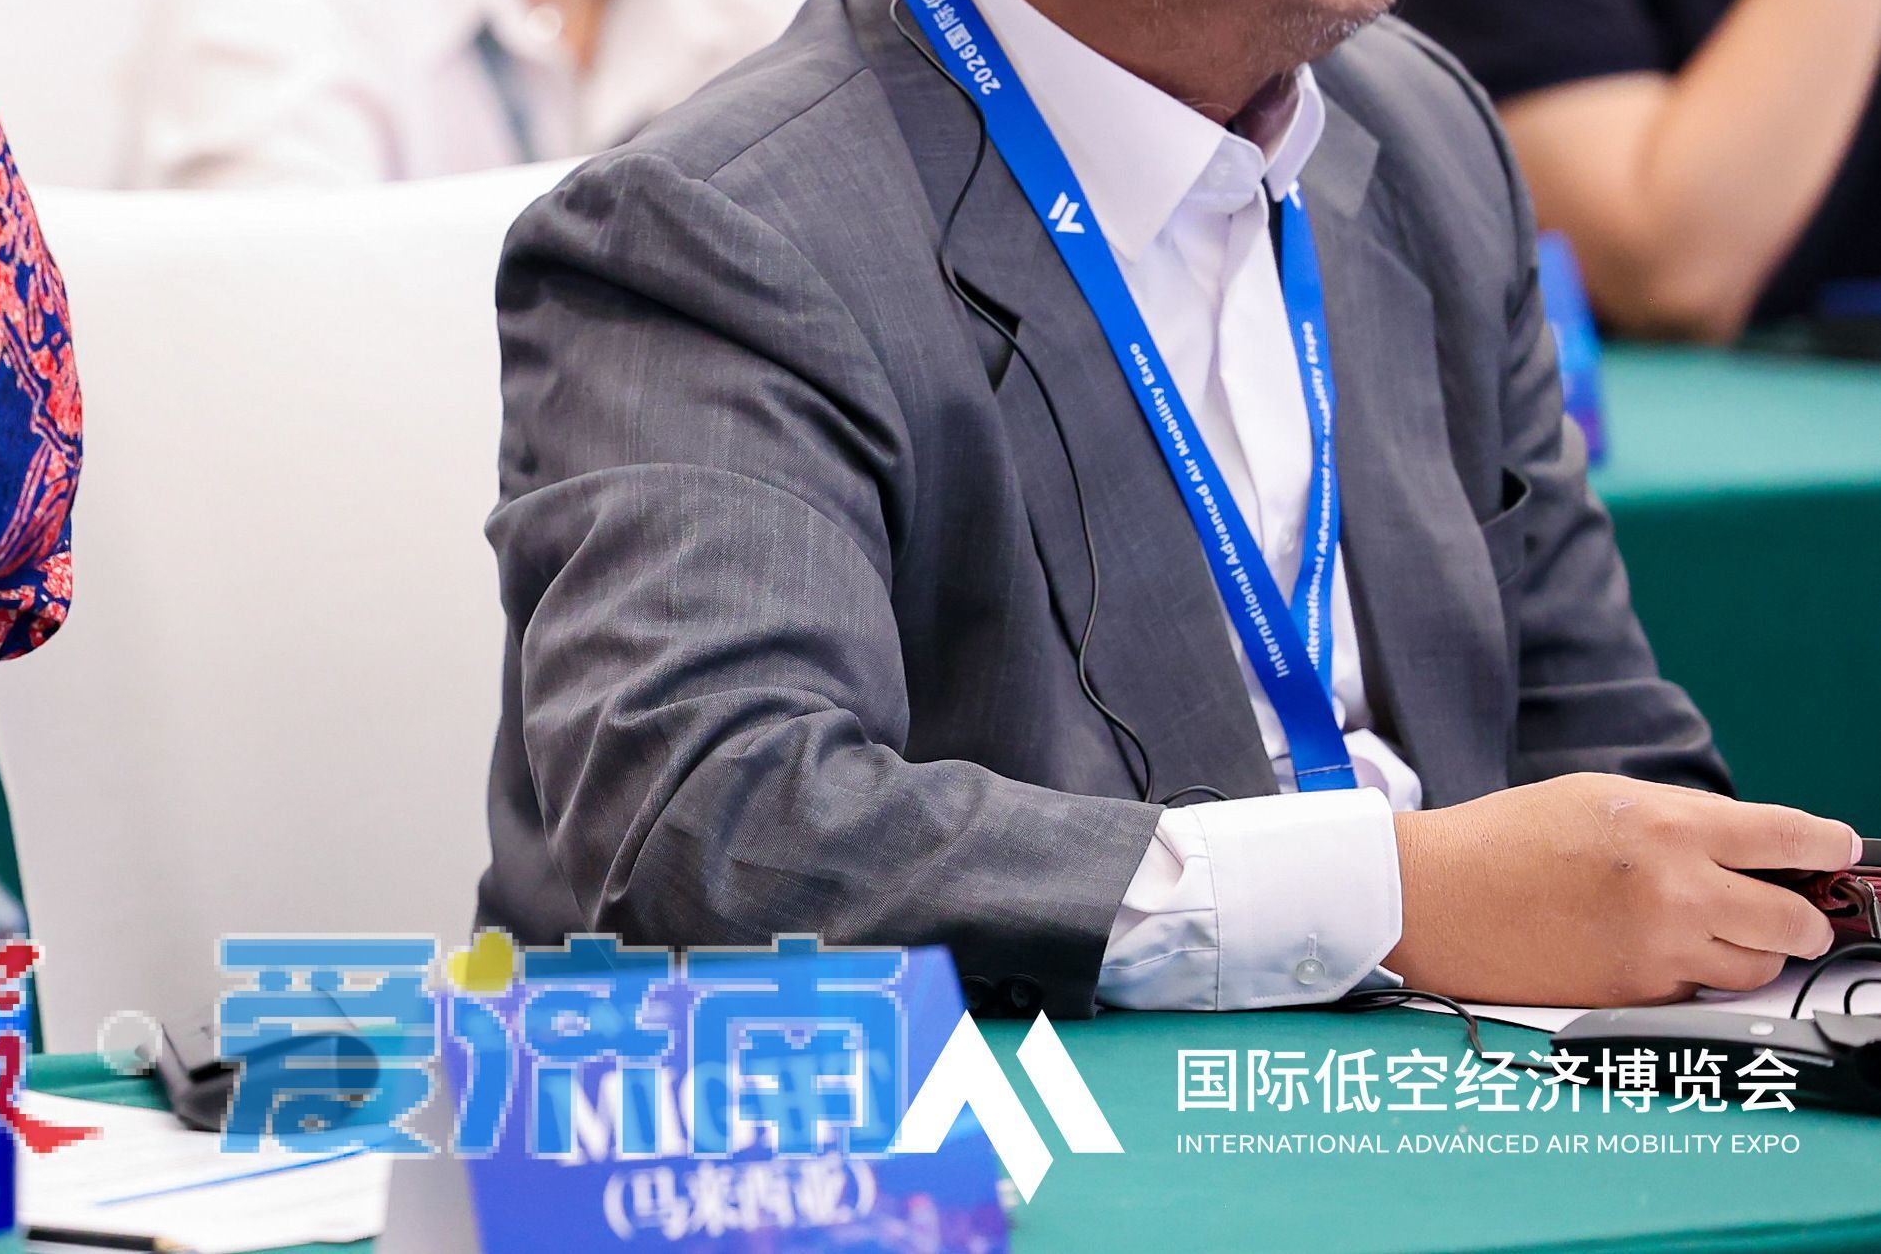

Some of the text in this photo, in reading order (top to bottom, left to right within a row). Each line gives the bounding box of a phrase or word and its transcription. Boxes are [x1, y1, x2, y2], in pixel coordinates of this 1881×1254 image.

[1129, 343, 1290, 678] International Advanced Air Mobility Expo
